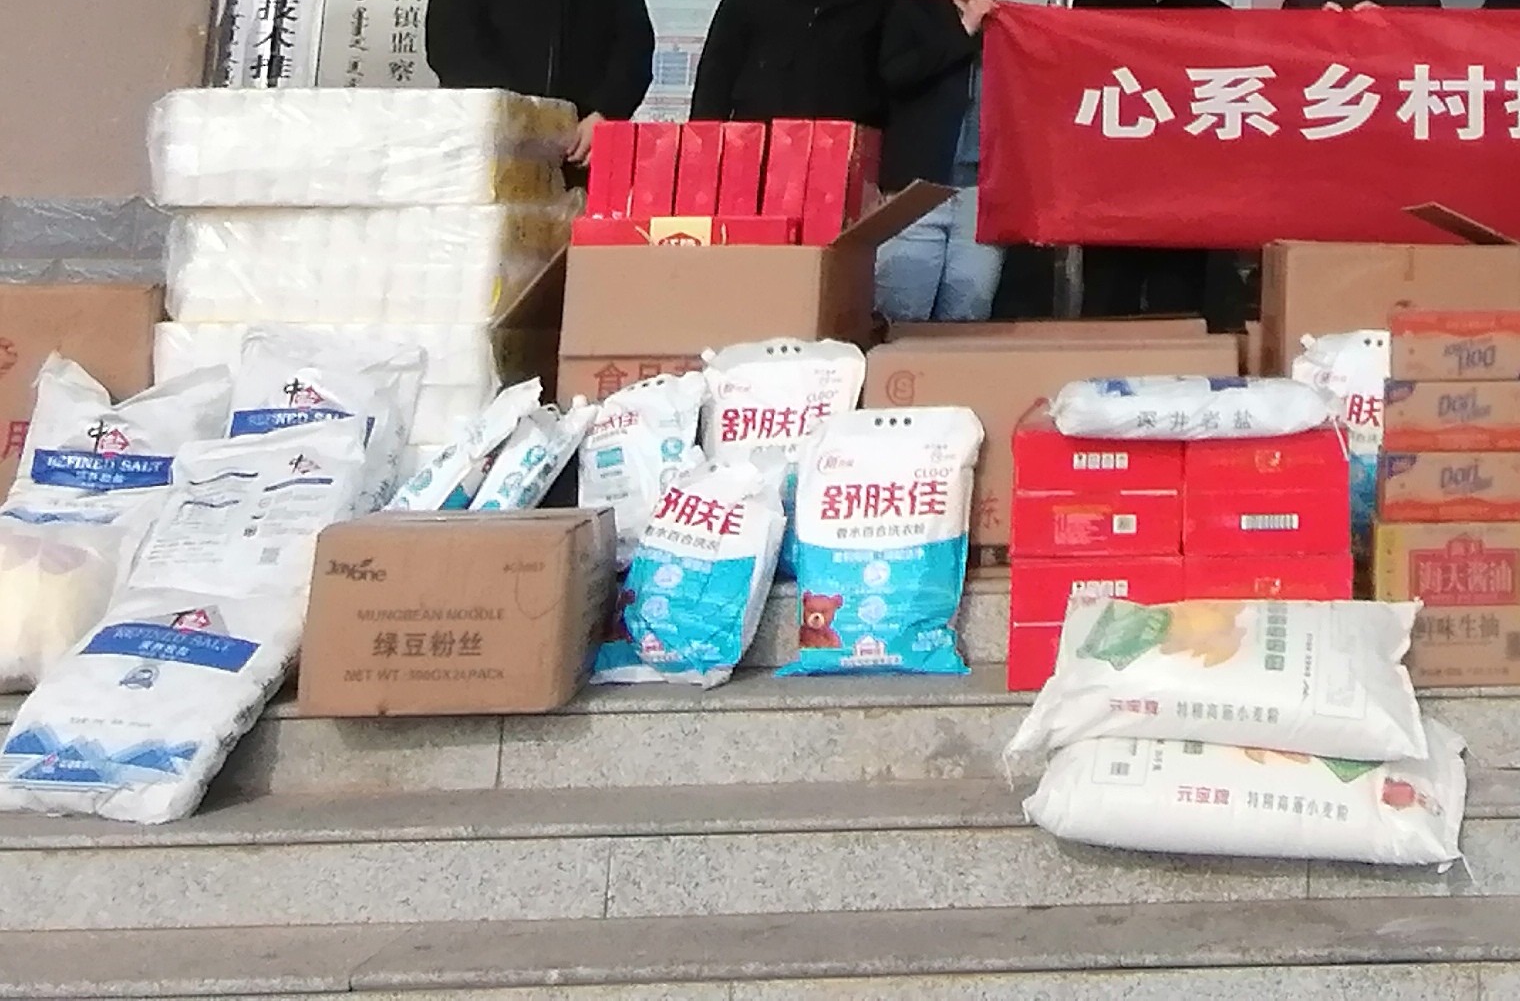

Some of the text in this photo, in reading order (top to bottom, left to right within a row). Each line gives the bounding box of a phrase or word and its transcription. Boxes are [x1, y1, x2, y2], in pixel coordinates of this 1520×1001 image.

[821, 480, 948, 520] 舒肤佳
[449, 607, 505, 622] NOODLE
[371, 630, 484, 658] 绿豆粉丝
